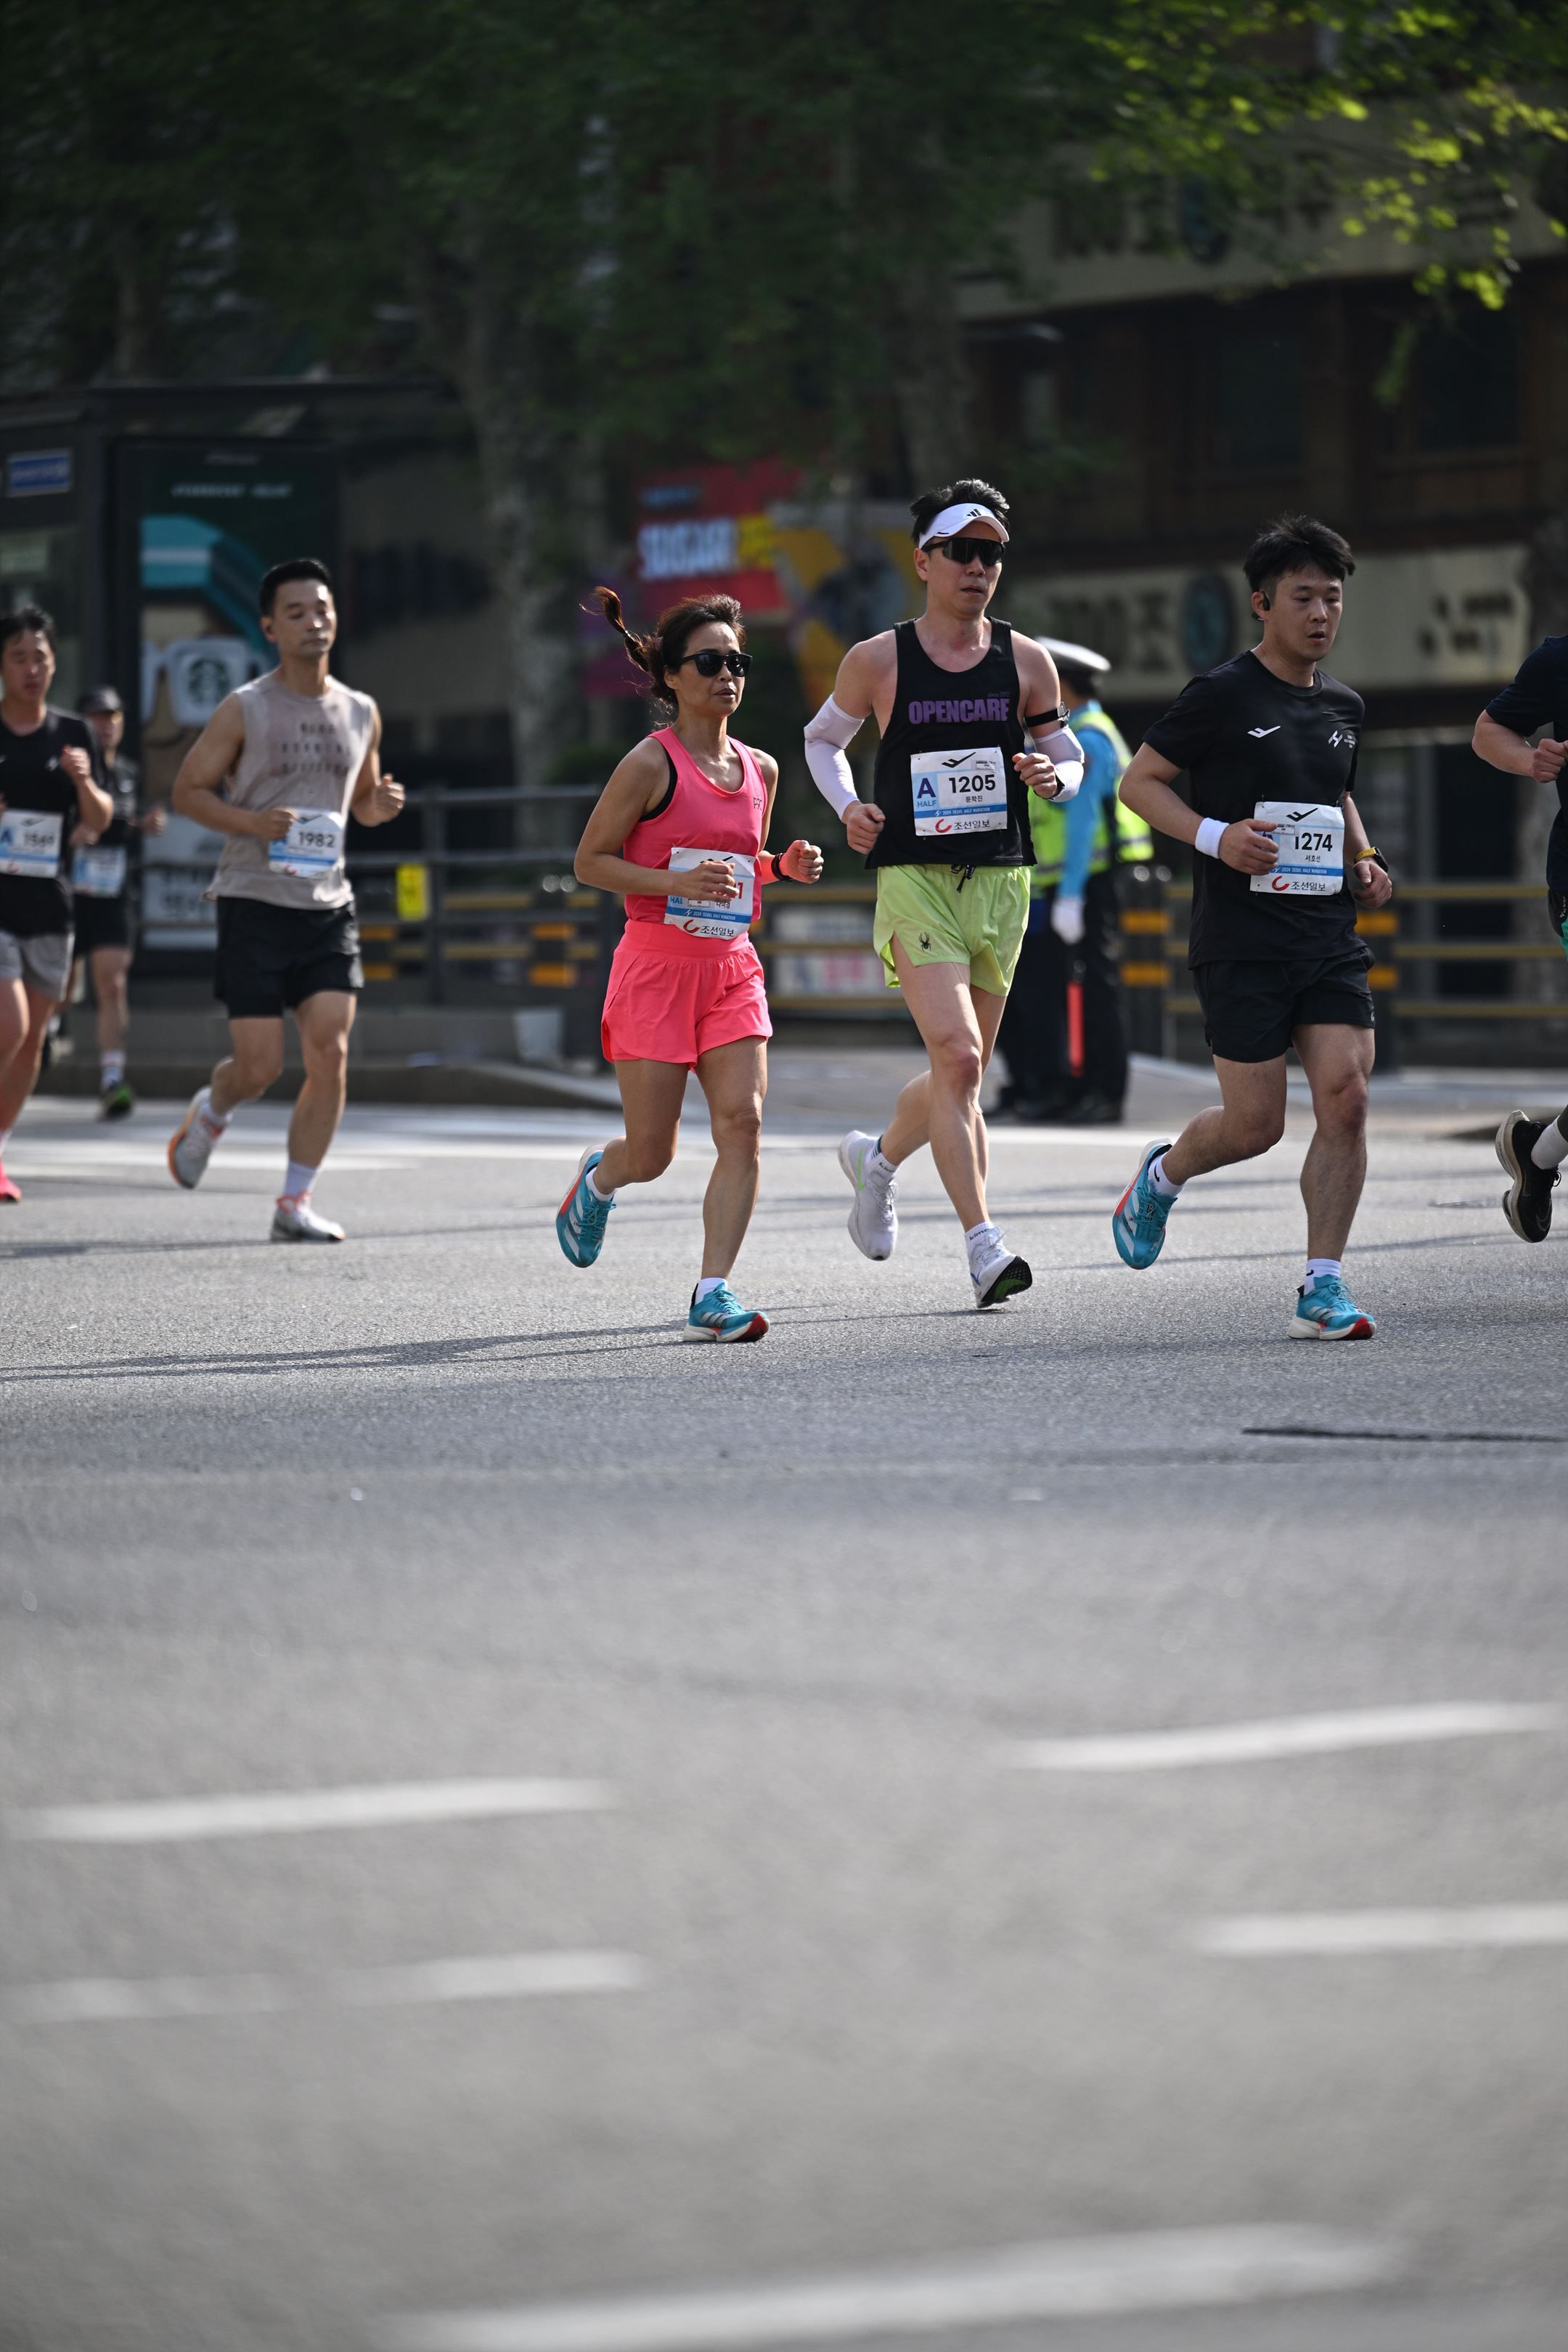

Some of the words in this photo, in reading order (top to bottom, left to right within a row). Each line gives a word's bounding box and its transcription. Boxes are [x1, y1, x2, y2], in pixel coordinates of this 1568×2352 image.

[908, 698, 1010, 724] OPENCARE
[917, 777, 936, 799] A
[949, 774, 996, 793] 1205
[954, 820, 991, 830] 조선일보
[299, 830, 336, 848] 1982
[1294, 833, 1333, 852] 1274
[1291, 881, 1326, 891] 조선일보
[700, 926, 734, 937] 조선일보
